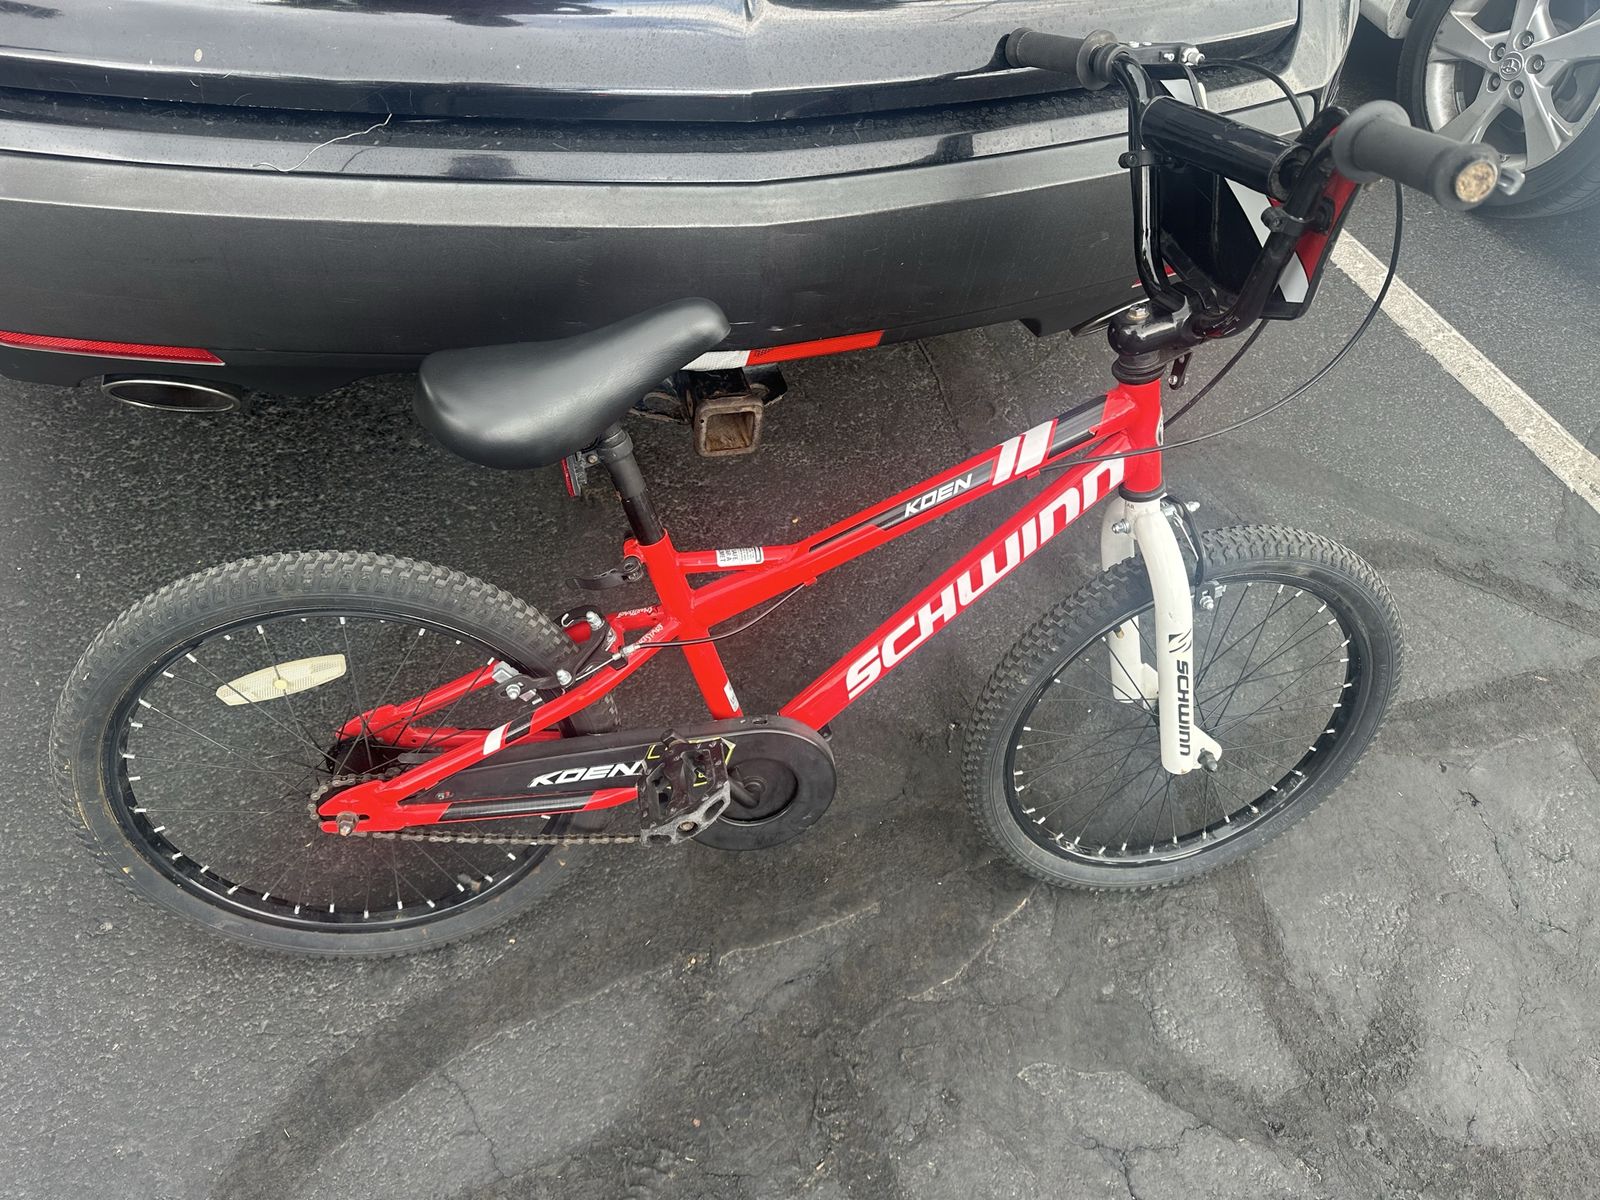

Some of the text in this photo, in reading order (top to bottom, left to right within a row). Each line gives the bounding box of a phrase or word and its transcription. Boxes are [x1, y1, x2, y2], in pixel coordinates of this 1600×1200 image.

[904, 473, 974, 518] KOEN
[845, 452, 1126, 700] SCHWINN
[1176, 659, 1191, 757] SCHWINN
[527, 761, 642, 787] KOEN
